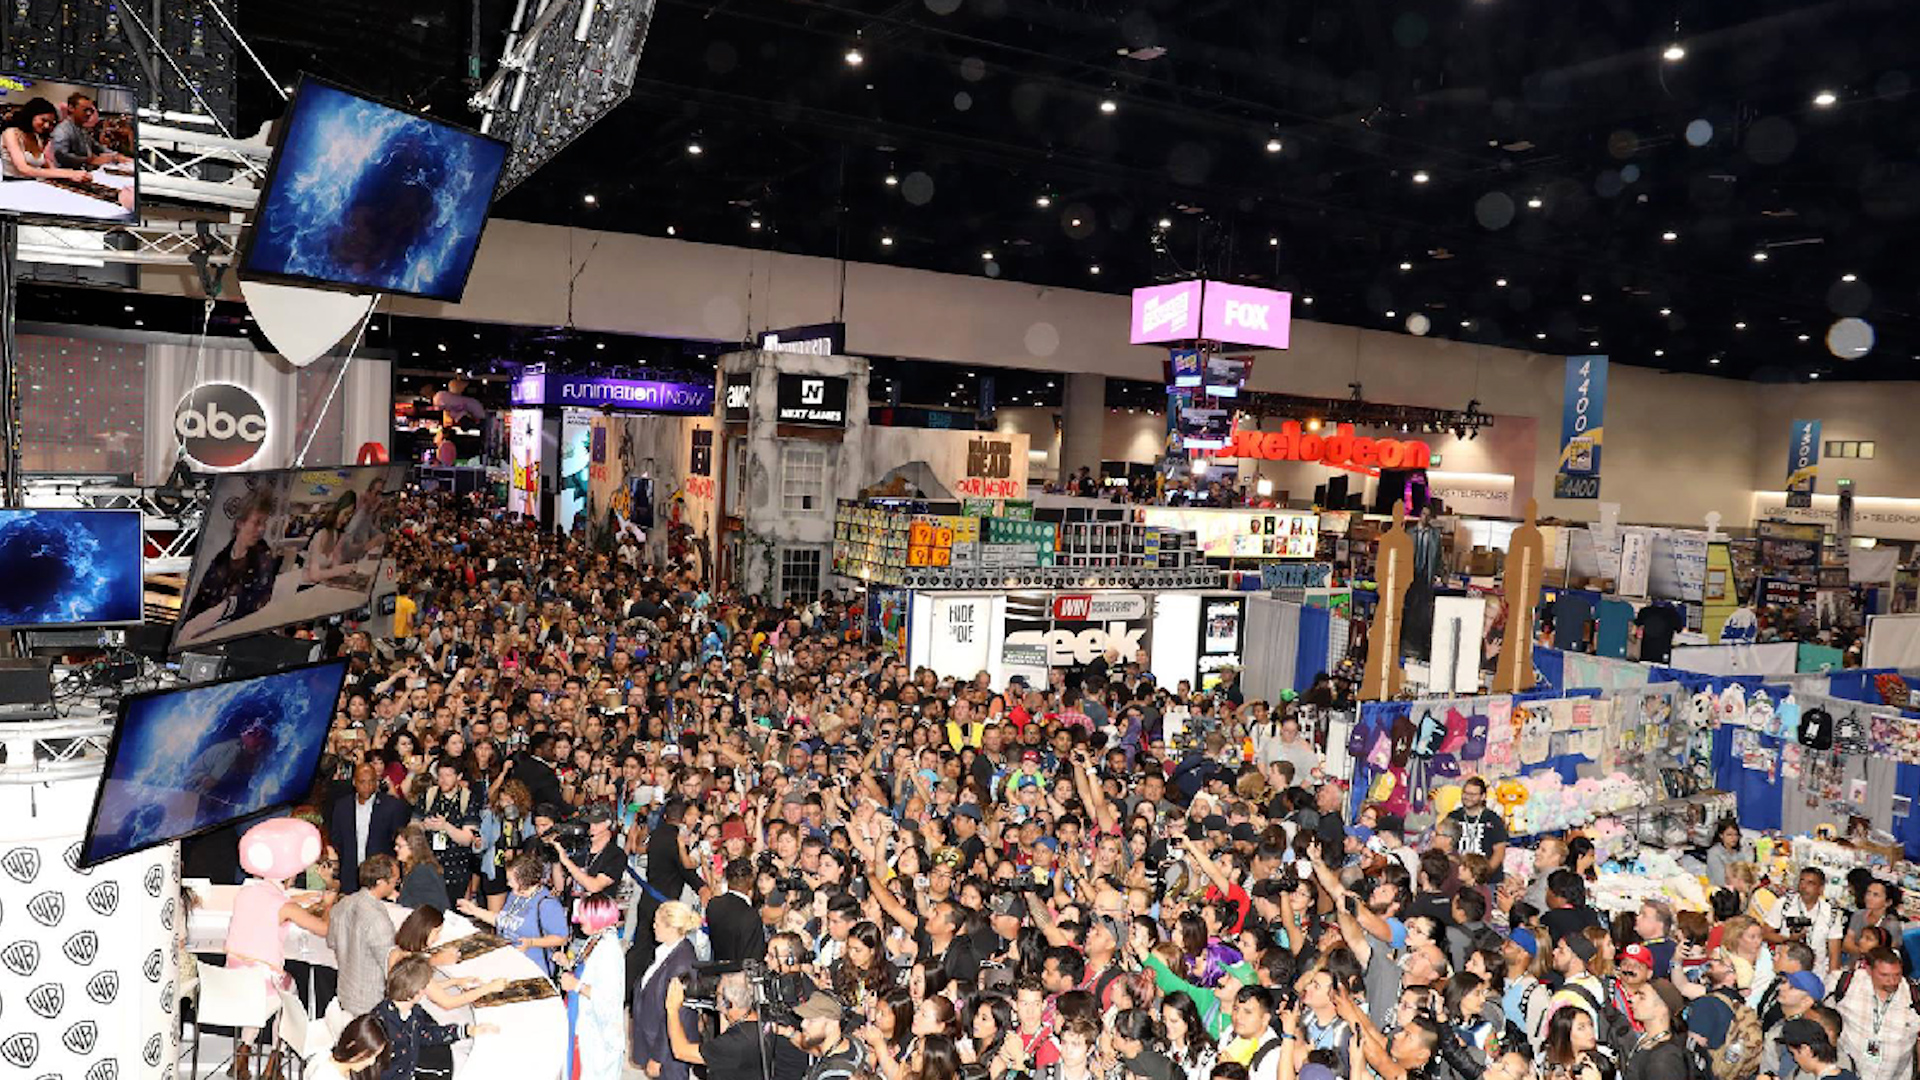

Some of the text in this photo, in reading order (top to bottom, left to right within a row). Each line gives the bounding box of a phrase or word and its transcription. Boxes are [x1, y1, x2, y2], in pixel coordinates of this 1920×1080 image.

[1225, 300, 1269, 331] FOX
[667, 390, 705, 406] NOW
[1574, 360, 1591, 432] 4400
[175, 402, 267, 442] abc
[780, 409, 842, 421] NEXT GAMES
[966, 454, 1011, 478] DEAD
[956, 478, 1019, 498] OUR WORLD
[1767, 581, 1800, 591] STEVE
[1060, 598, 1089, 617] WIN
